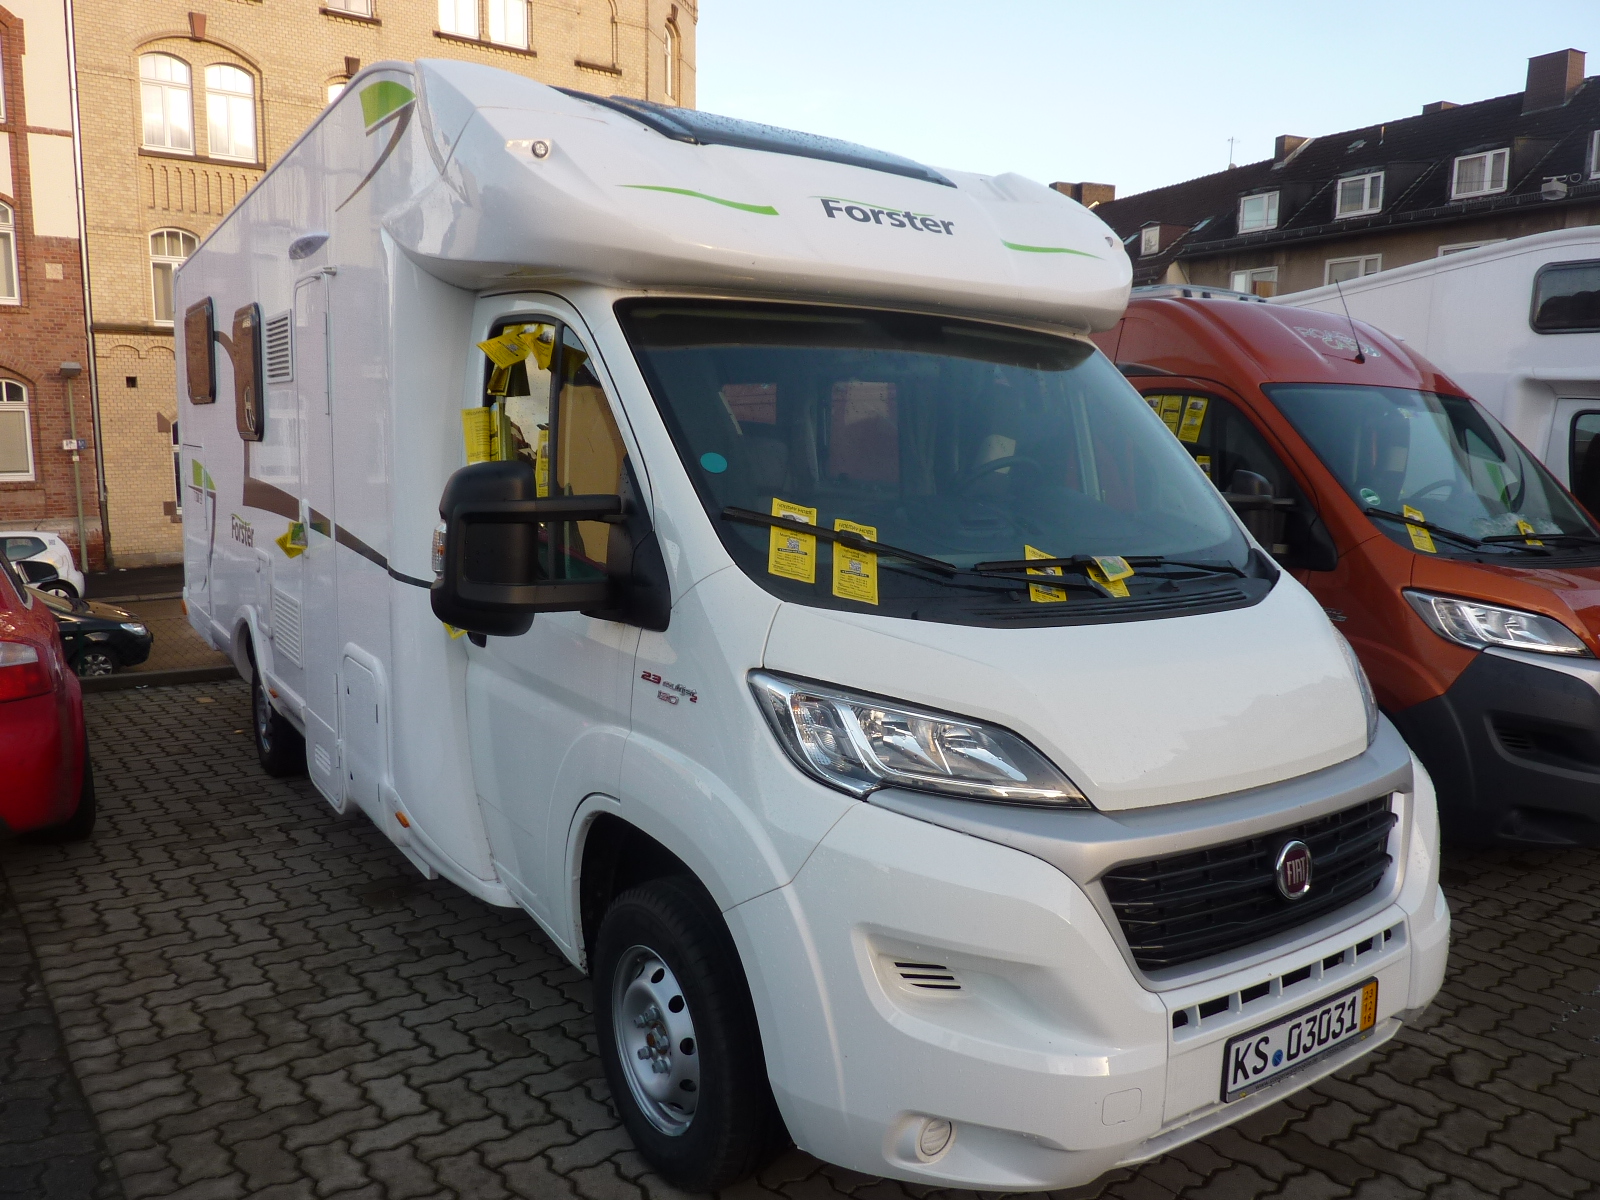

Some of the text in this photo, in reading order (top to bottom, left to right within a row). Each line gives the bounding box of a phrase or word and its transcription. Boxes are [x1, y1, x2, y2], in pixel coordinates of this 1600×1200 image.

[820, 198, 955, 236] Forster
[1286, 856, 1306, 886] FIAT
[1364, 1000, 1373, 1013] 12
[1232, 1035, 1270, 1085] KS
[1286, 995, 1358, 1062] 03031
